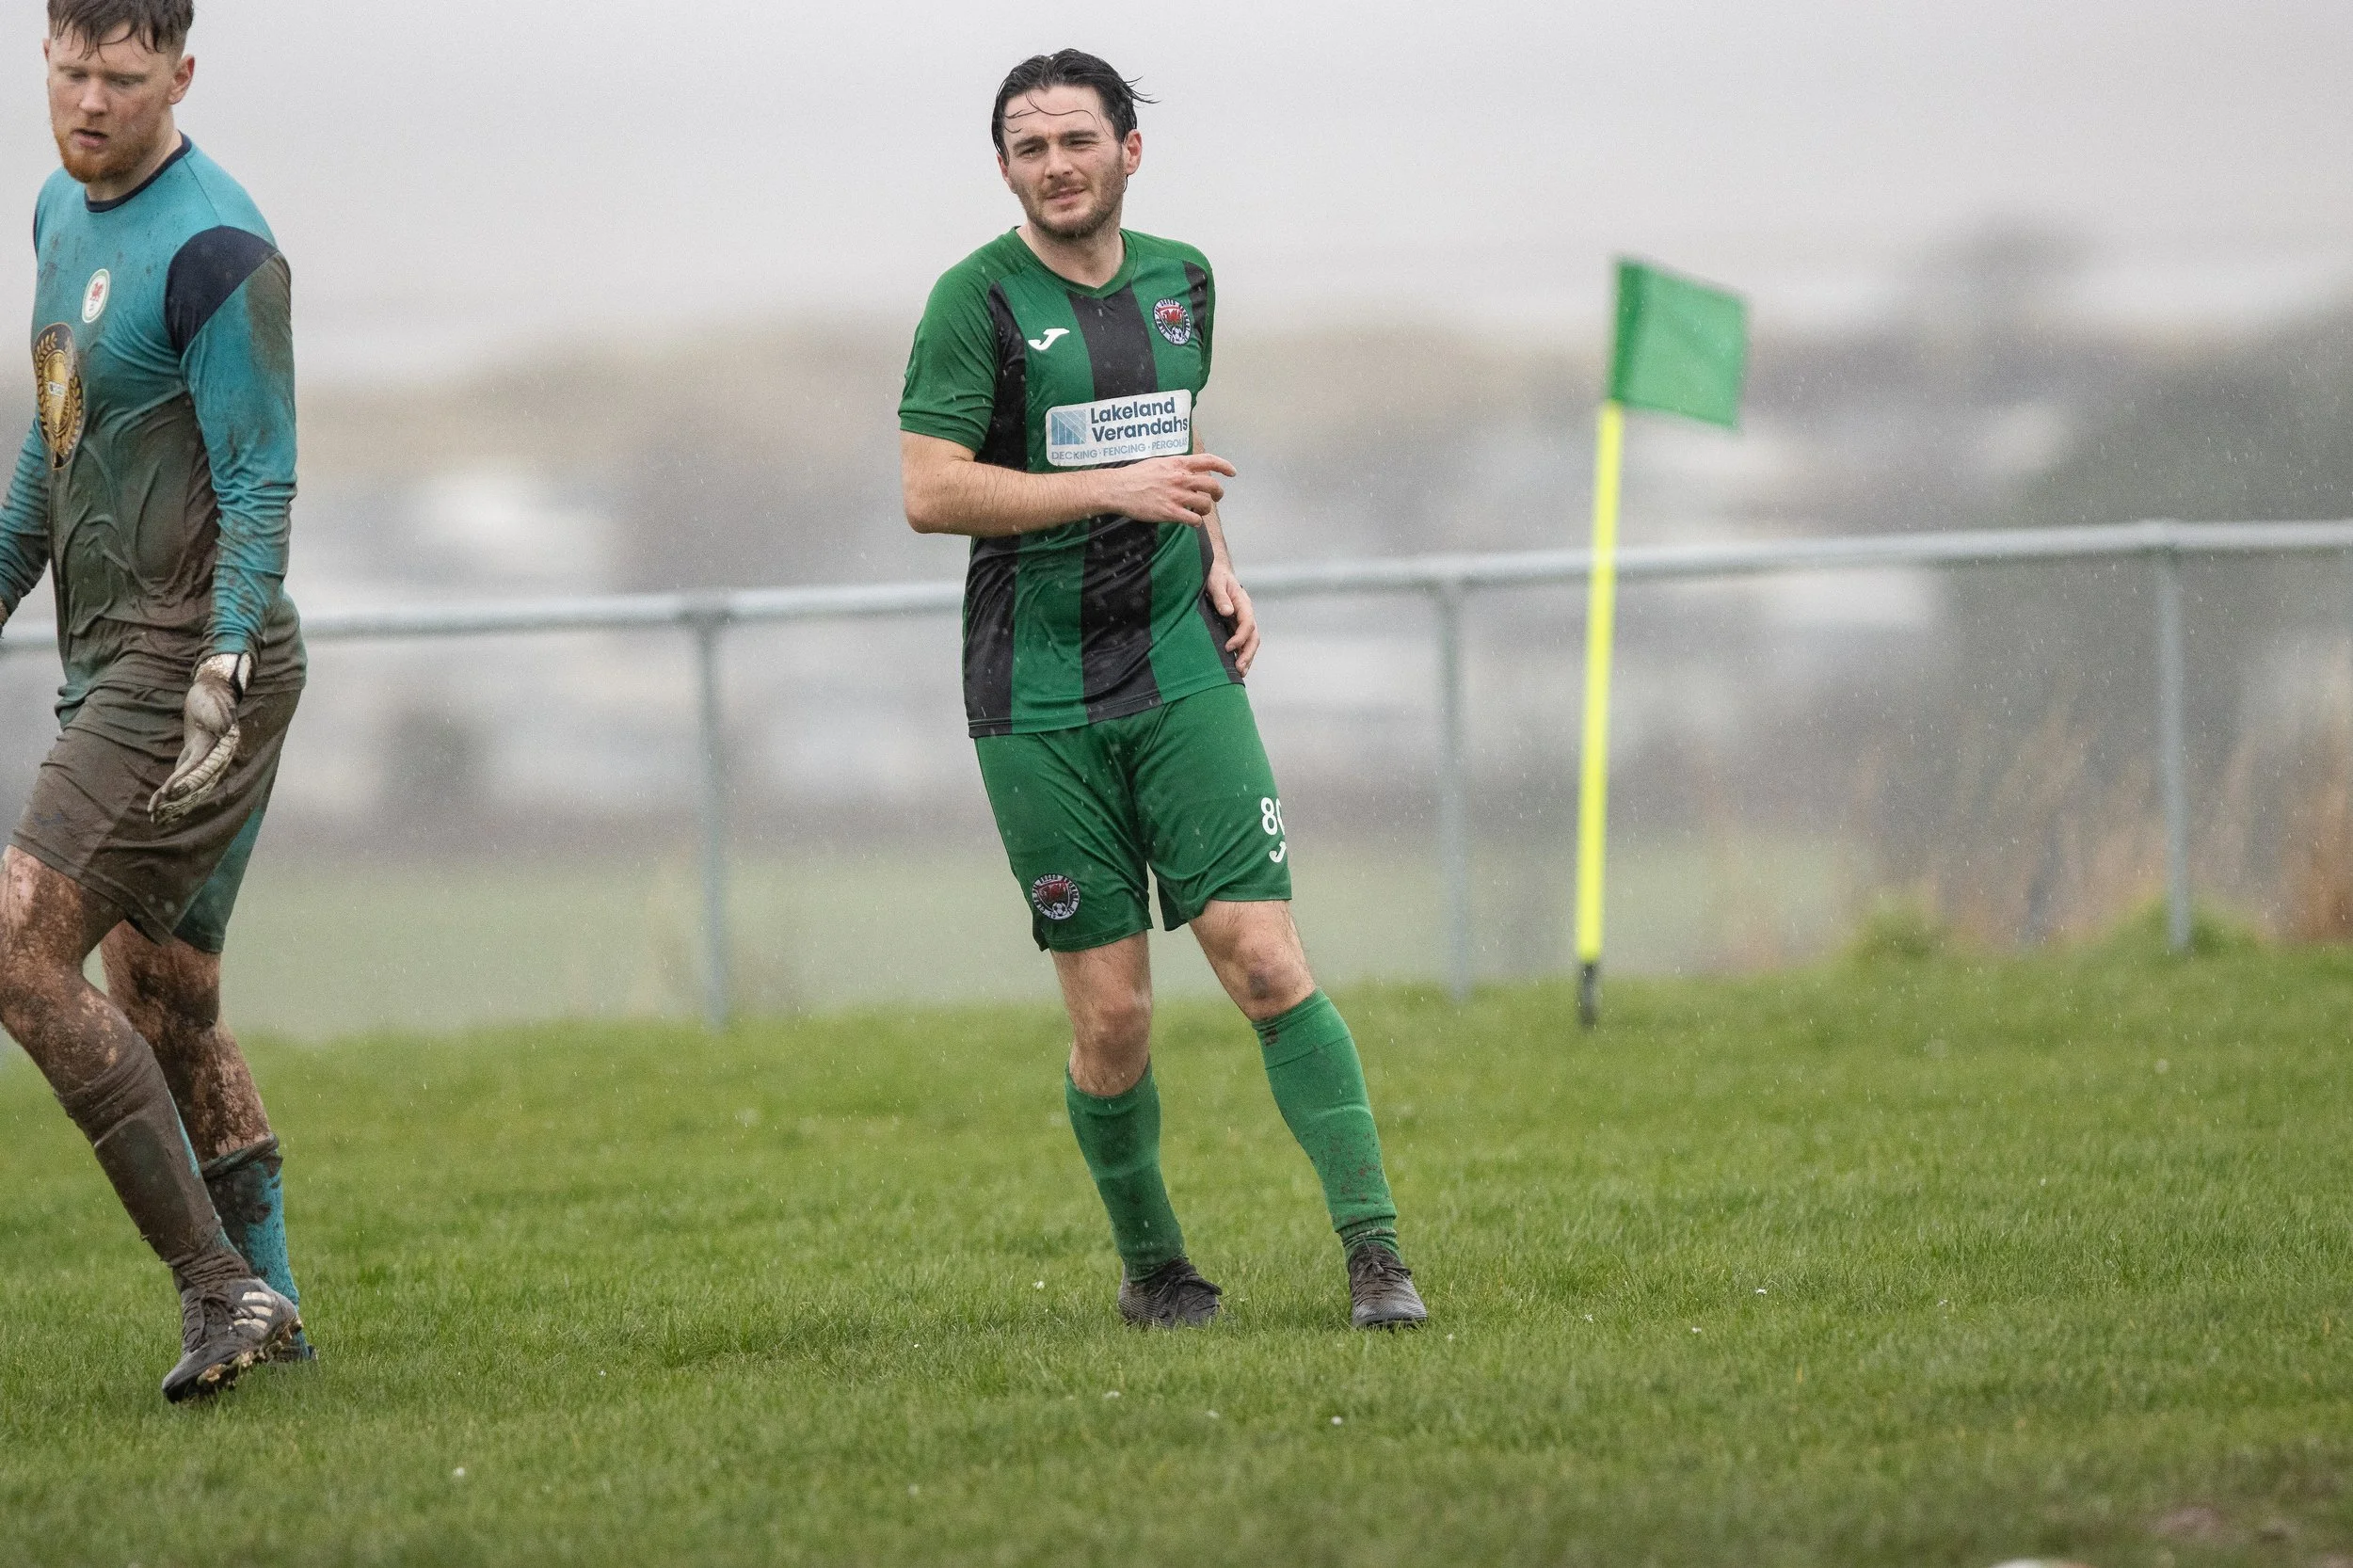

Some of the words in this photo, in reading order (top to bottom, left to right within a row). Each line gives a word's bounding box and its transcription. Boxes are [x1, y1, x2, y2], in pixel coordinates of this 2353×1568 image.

[1090, 396, 1176, 424] Lakeland
[1092, 416, 1189, 442] Verandahs
[1051, 451, 1098, 460] DECKING
[1103, 443, 1146, 456] FENCING
